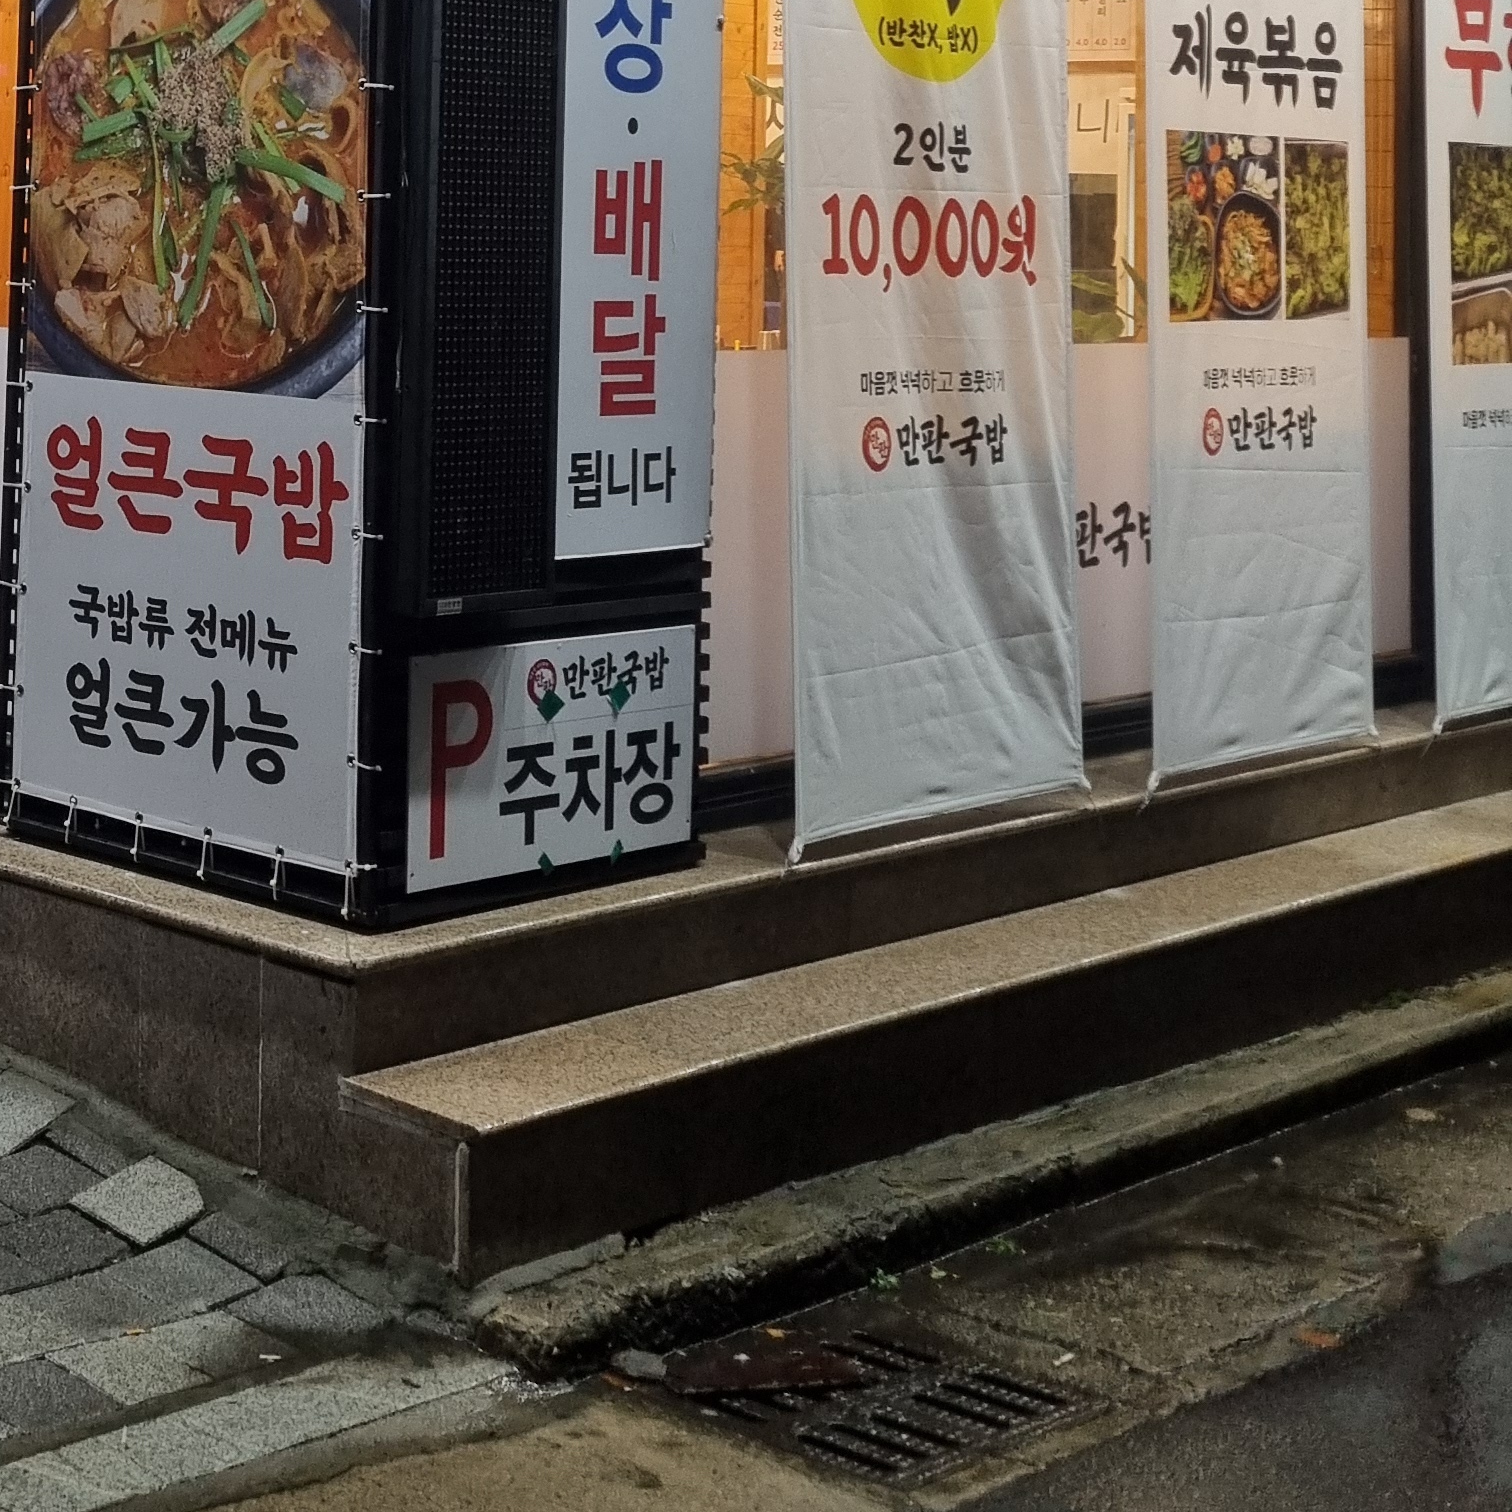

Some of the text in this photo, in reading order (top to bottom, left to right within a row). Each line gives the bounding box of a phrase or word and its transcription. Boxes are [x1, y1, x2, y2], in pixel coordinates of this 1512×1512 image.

[1169, 3, 1343, 110] 제육볶음
[892, 120, 973, 174] 2인분
[895, 413, 1008, 468] 만판국밥
[1227, 404, 1318, 452] 만판국밥
[46, 415, 350, 565] 얼큰국밥
[567, 444, 678, 510] 됩니다
[68, 583, 299, 675] 국밥류 전메뉴
[562, 644, 670, 701] 만판국밥
[65, 657, 300, 786] 얼큰가능
[429, 679, 494, 861] P
[499, 720, 681, 847] 주차장
